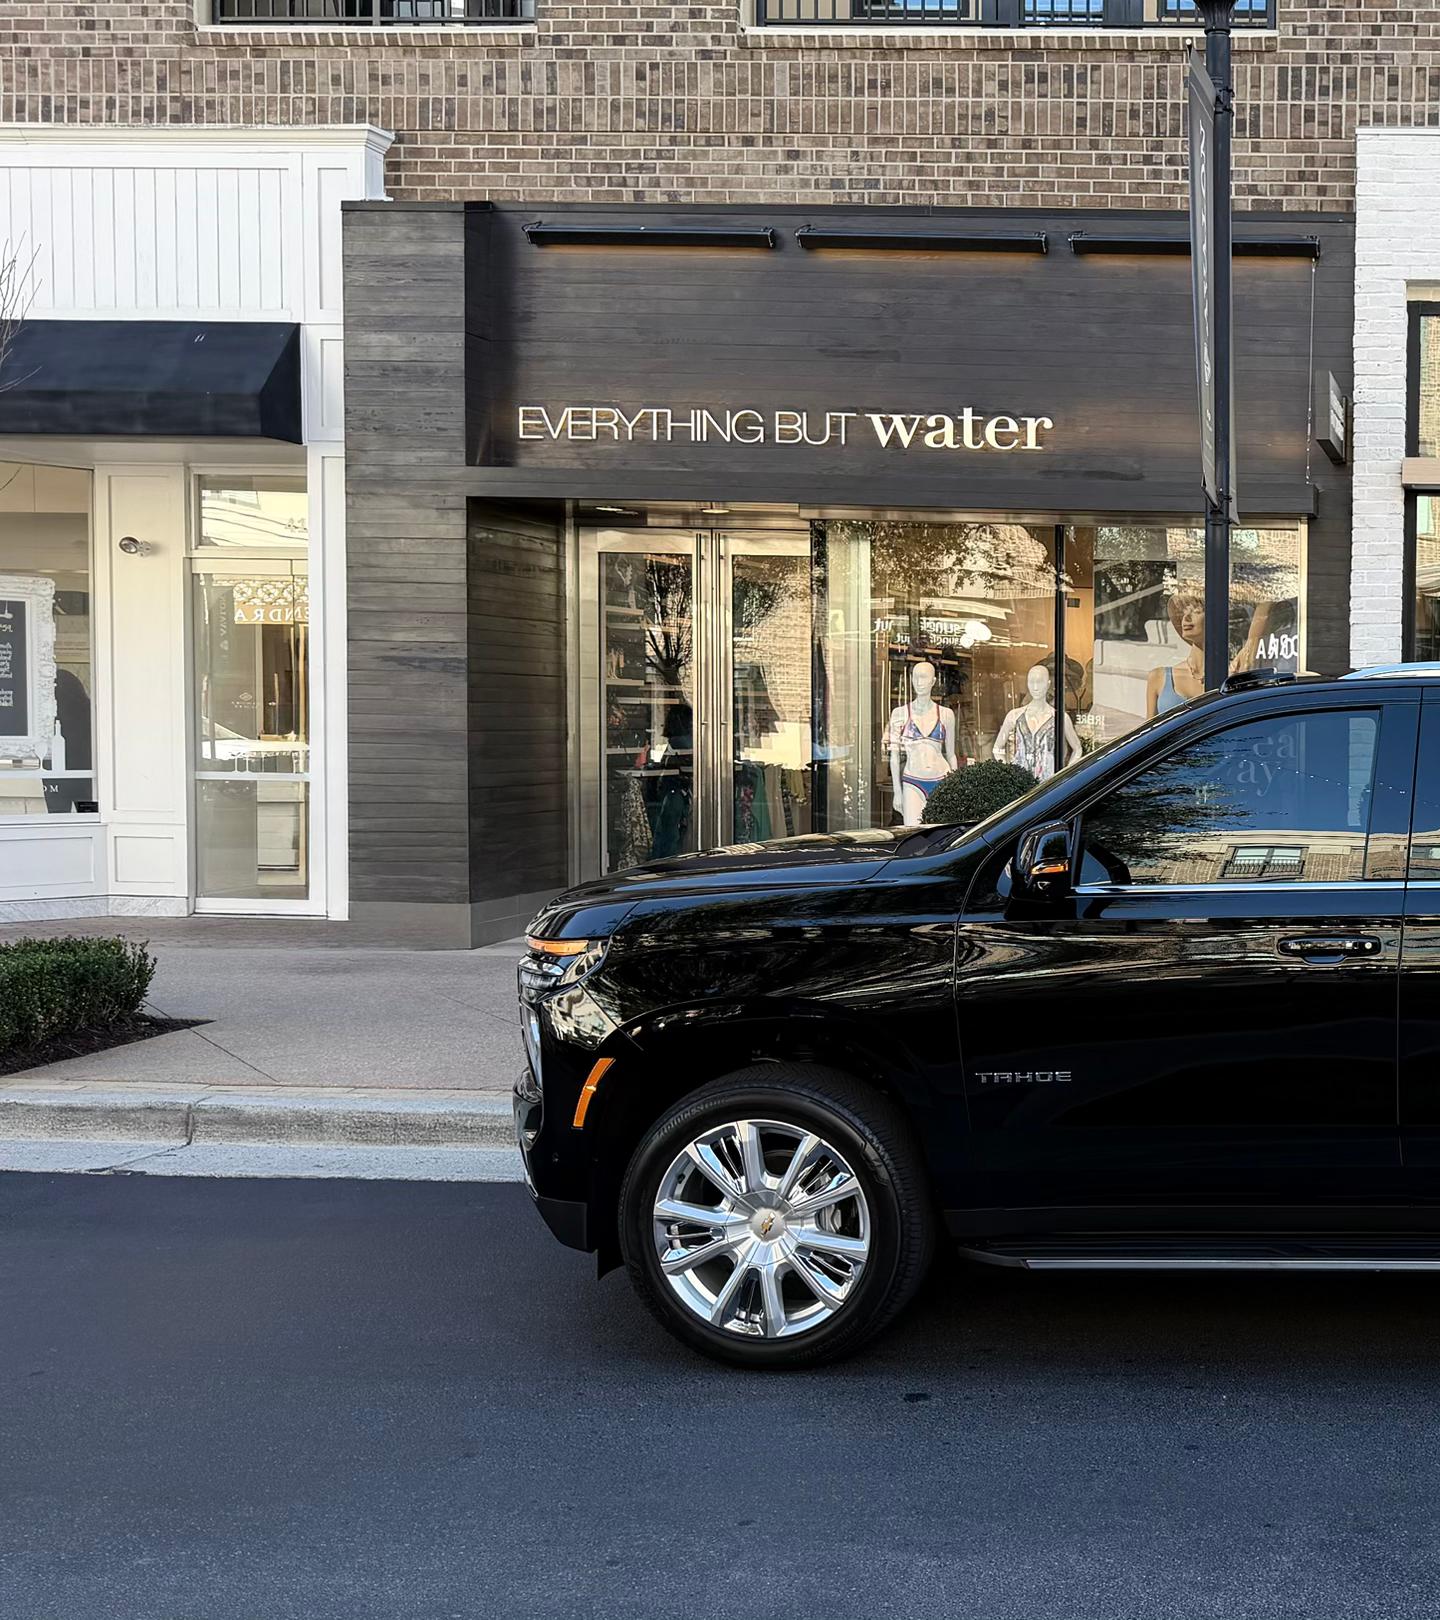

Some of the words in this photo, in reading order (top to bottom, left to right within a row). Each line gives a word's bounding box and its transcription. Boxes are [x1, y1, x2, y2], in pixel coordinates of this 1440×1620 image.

[518, 406, 765, 444] EVERYTHING
[774, 409, 856, 445] BUT
[865, 406, 1054, 451] water
[975, 1071, 1072, 1084] TAHOE
